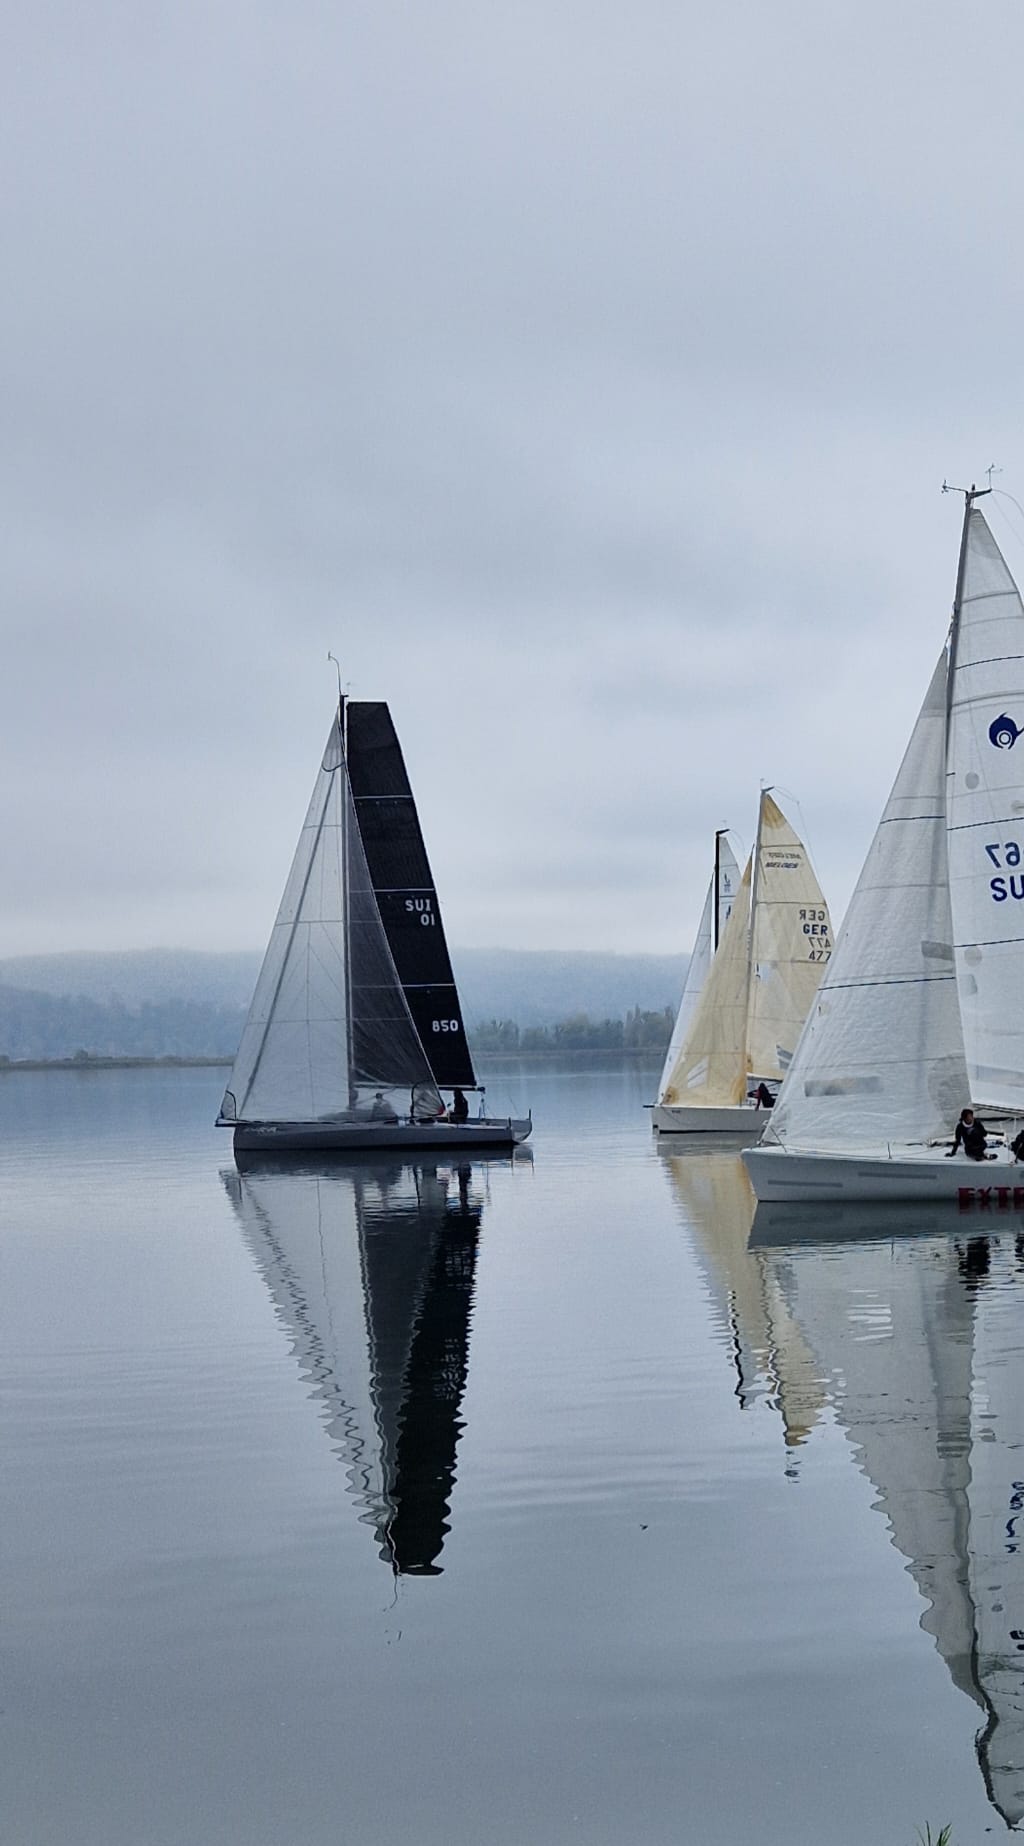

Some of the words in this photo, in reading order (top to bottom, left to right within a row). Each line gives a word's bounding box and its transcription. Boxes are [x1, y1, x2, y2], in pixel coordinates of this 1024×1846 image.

[404, 898, 431, 912] SUI
[803, 924, 828, 935] GER
[808, 950, 832, 962] 477
[431, 1019, 459, 1033] 850
